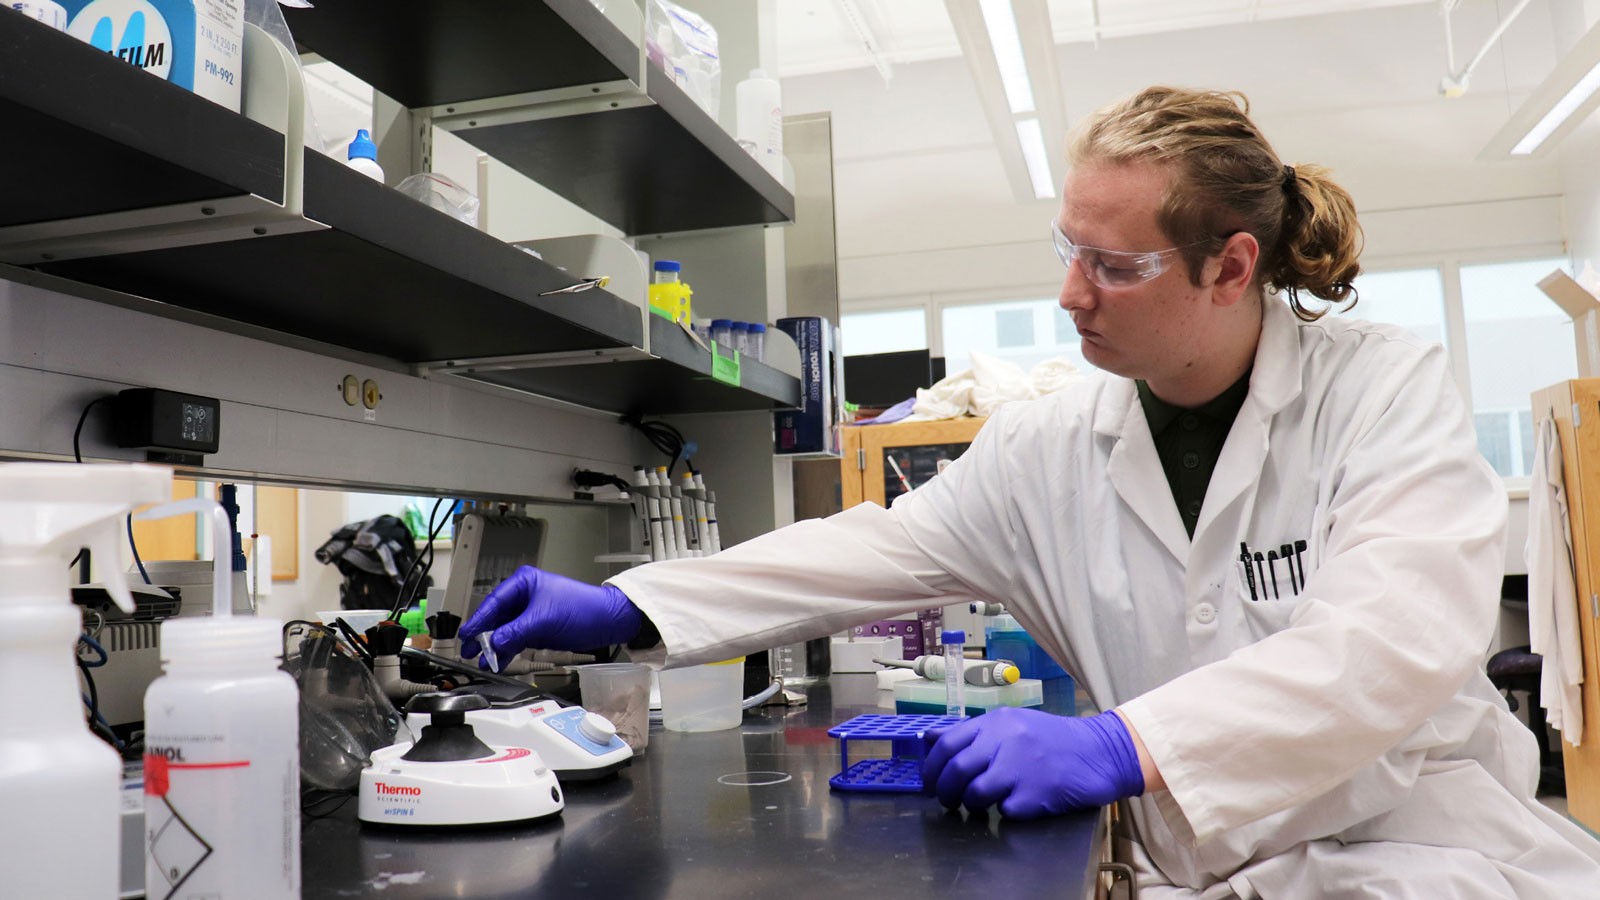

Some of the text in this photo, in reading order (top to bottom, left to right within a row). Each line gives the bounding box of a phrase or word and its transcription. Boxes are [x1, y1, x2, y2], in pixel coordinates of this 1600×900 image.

[108, 42, 165, 68] FILM
[205, 59, 234, 86] PM-992
[375, 782, 421, 796] Thermo
[377, 796, 420, 804] SCIENTIFIC
